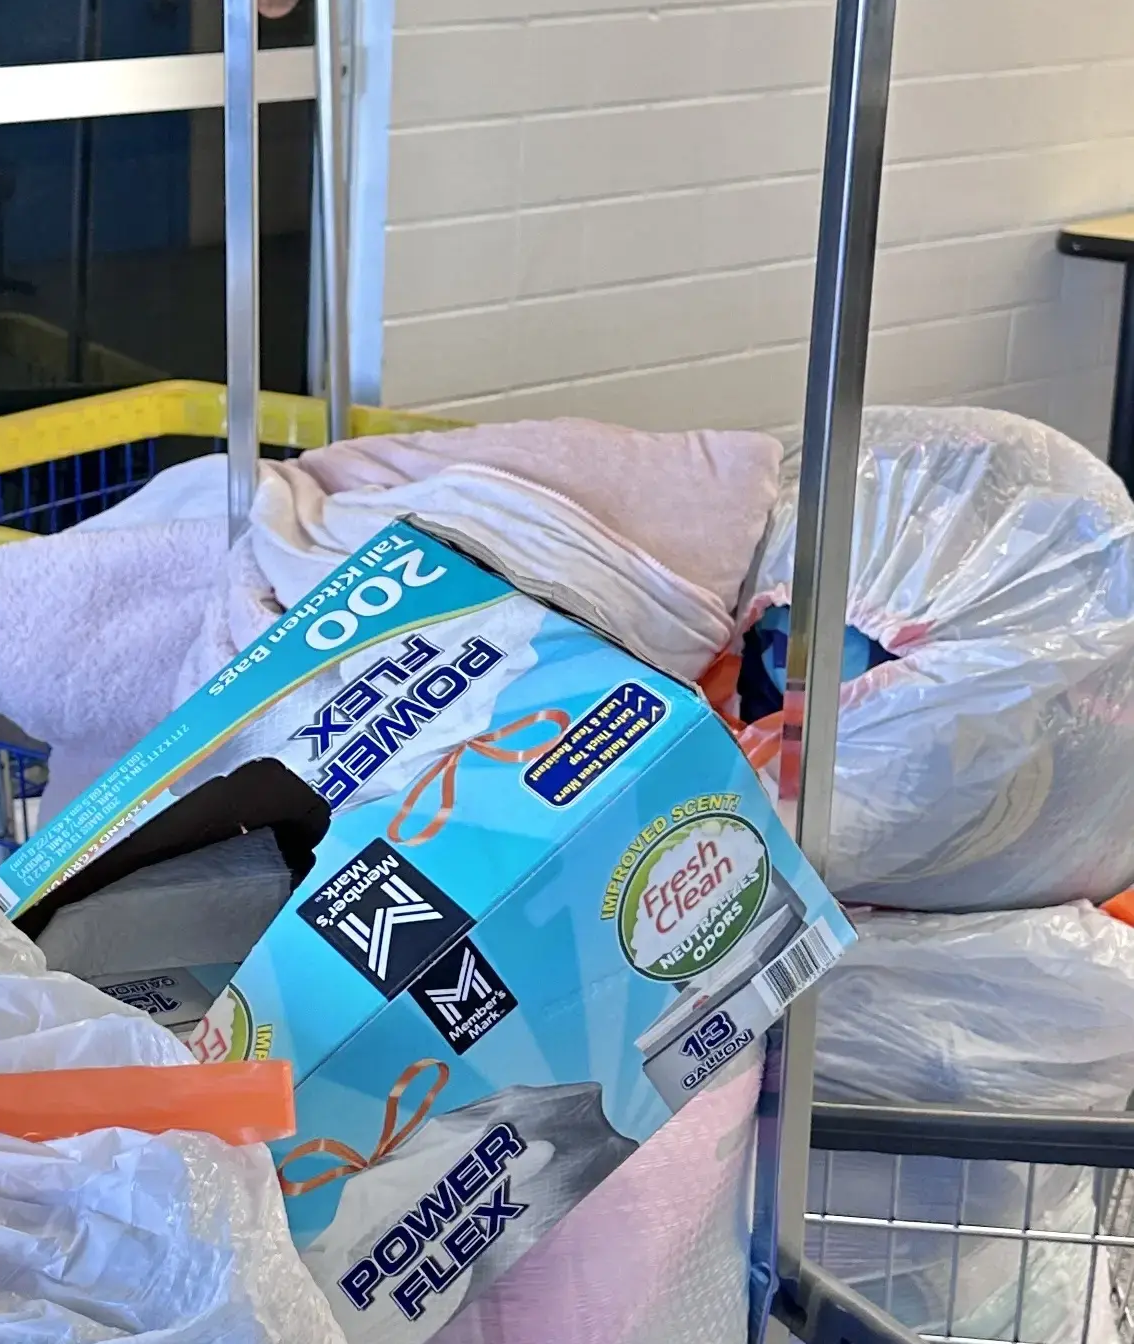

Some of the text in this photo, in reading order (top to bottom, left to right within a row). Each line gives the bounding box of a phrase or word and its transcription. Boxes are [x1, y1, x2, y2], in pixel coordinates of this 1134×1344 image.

[208, 534, 413, 696] Tall Kitchen Bags
[305, 548, 447, 650] 200
[291, 634, 444, 758] FLEX
[310, 635, 507, 811] POWER
[571, 726, 594, 744] Tear
[597, 698, 622, 719] Leak
[529, 742, 573, 781] Resistant
[553, 717, 649, 802] Now Holds Even More
[569, 708, 635, 766] Extra Thick Top
[316, 855, 399, 927] Member's
[600, 793, 741, 920] IMPROVED SCENT!
[642, 840, 718, 917] Fresh
[655, 855, 732, 935] Clean
[659, 871, 760, 970] NEUTRALIZES
[692, 902, 743, 962] ODORS
[449, 990, 506, 1041] Member's
[680, 1010, 736, 1061] 13
[681, 1029, 754, 1090] GALLON
[337, 1123, 526, 1310] POWER
[390, 1175, 529, 1320] FLEX
